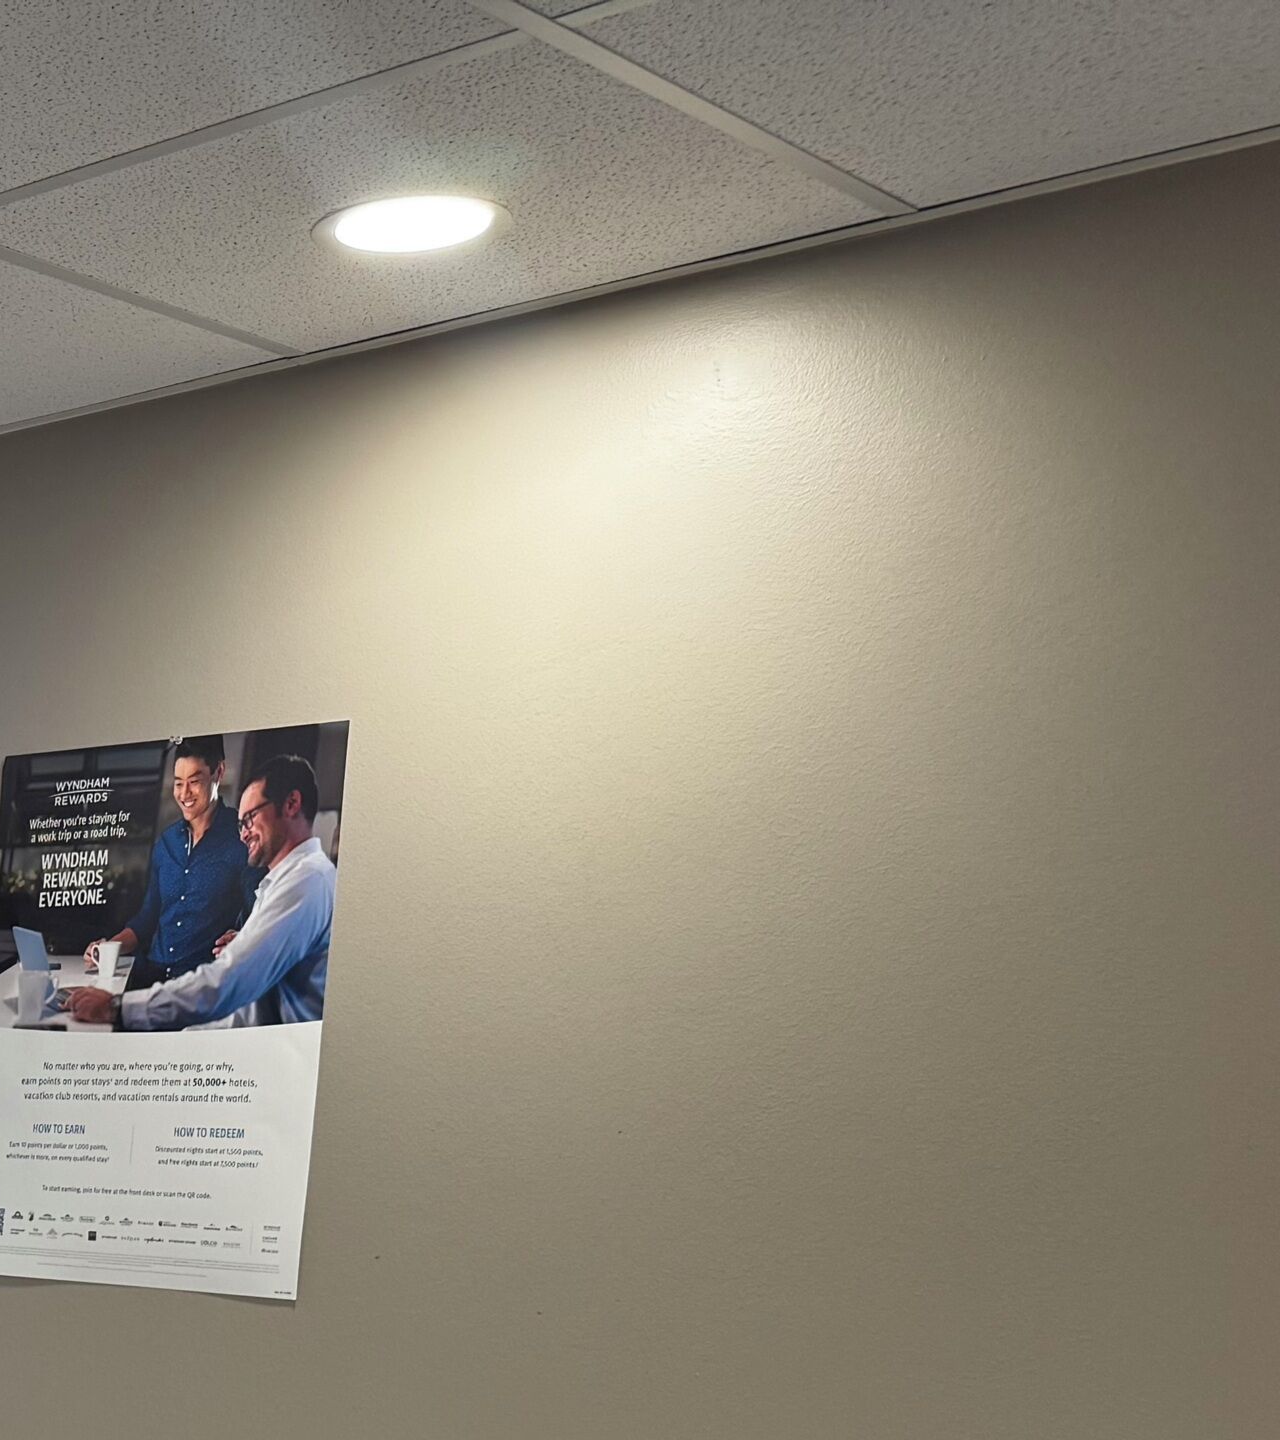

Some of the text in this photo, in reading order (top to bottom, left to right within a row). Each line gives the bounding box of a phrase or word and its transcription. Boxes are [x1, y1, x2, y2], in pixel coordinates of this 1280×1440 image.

[55, 777, 110, 791] WYNDHAM
[54, 792, 108, 807] REWARDS
[29, 810, 130, 830] Whether you're staying for
[30, 825, 127, 843] a work trip or a road trip,
[42, 849, 108, 870] WYNDHAM
[43, 869, 103, 888] REWARDS
[39, 888, 106, 908] EVERYONE.
[43, 1062, 53, 1070] No
[55, 1062, 79, 1071] matter
[80, 1062, 95, 1071] who
[97, 1063, 110, 1072] you
[112, 1063, 127, 1071] are,
[128, 1062, 152, 1071] where
[153, 1062, 178, 1072] you're
[179, 1062, 203, 1073] going,
[205, 1063, 214, 1071] or
[21, 1078, 37, 1086] earn
[38, 1077, 61, 1087] points
[73, 1078, 90, 1087] your
[114, 1077, 128, 1086] and
[130, 1077, 160, 1087] redeem
[161, 1077, 181, 1087] them
[183, 1078, 191, 1087] at
[192, 1078, 227, 1087] 50,000+
[23, 1091, 251, 1103] vacation club resorts, and vacation rentals around the world.
[32, 1123, 86, 1135] HOW TO EARN
[173, 1127, 245, 1139] HOW TO REDEEM
